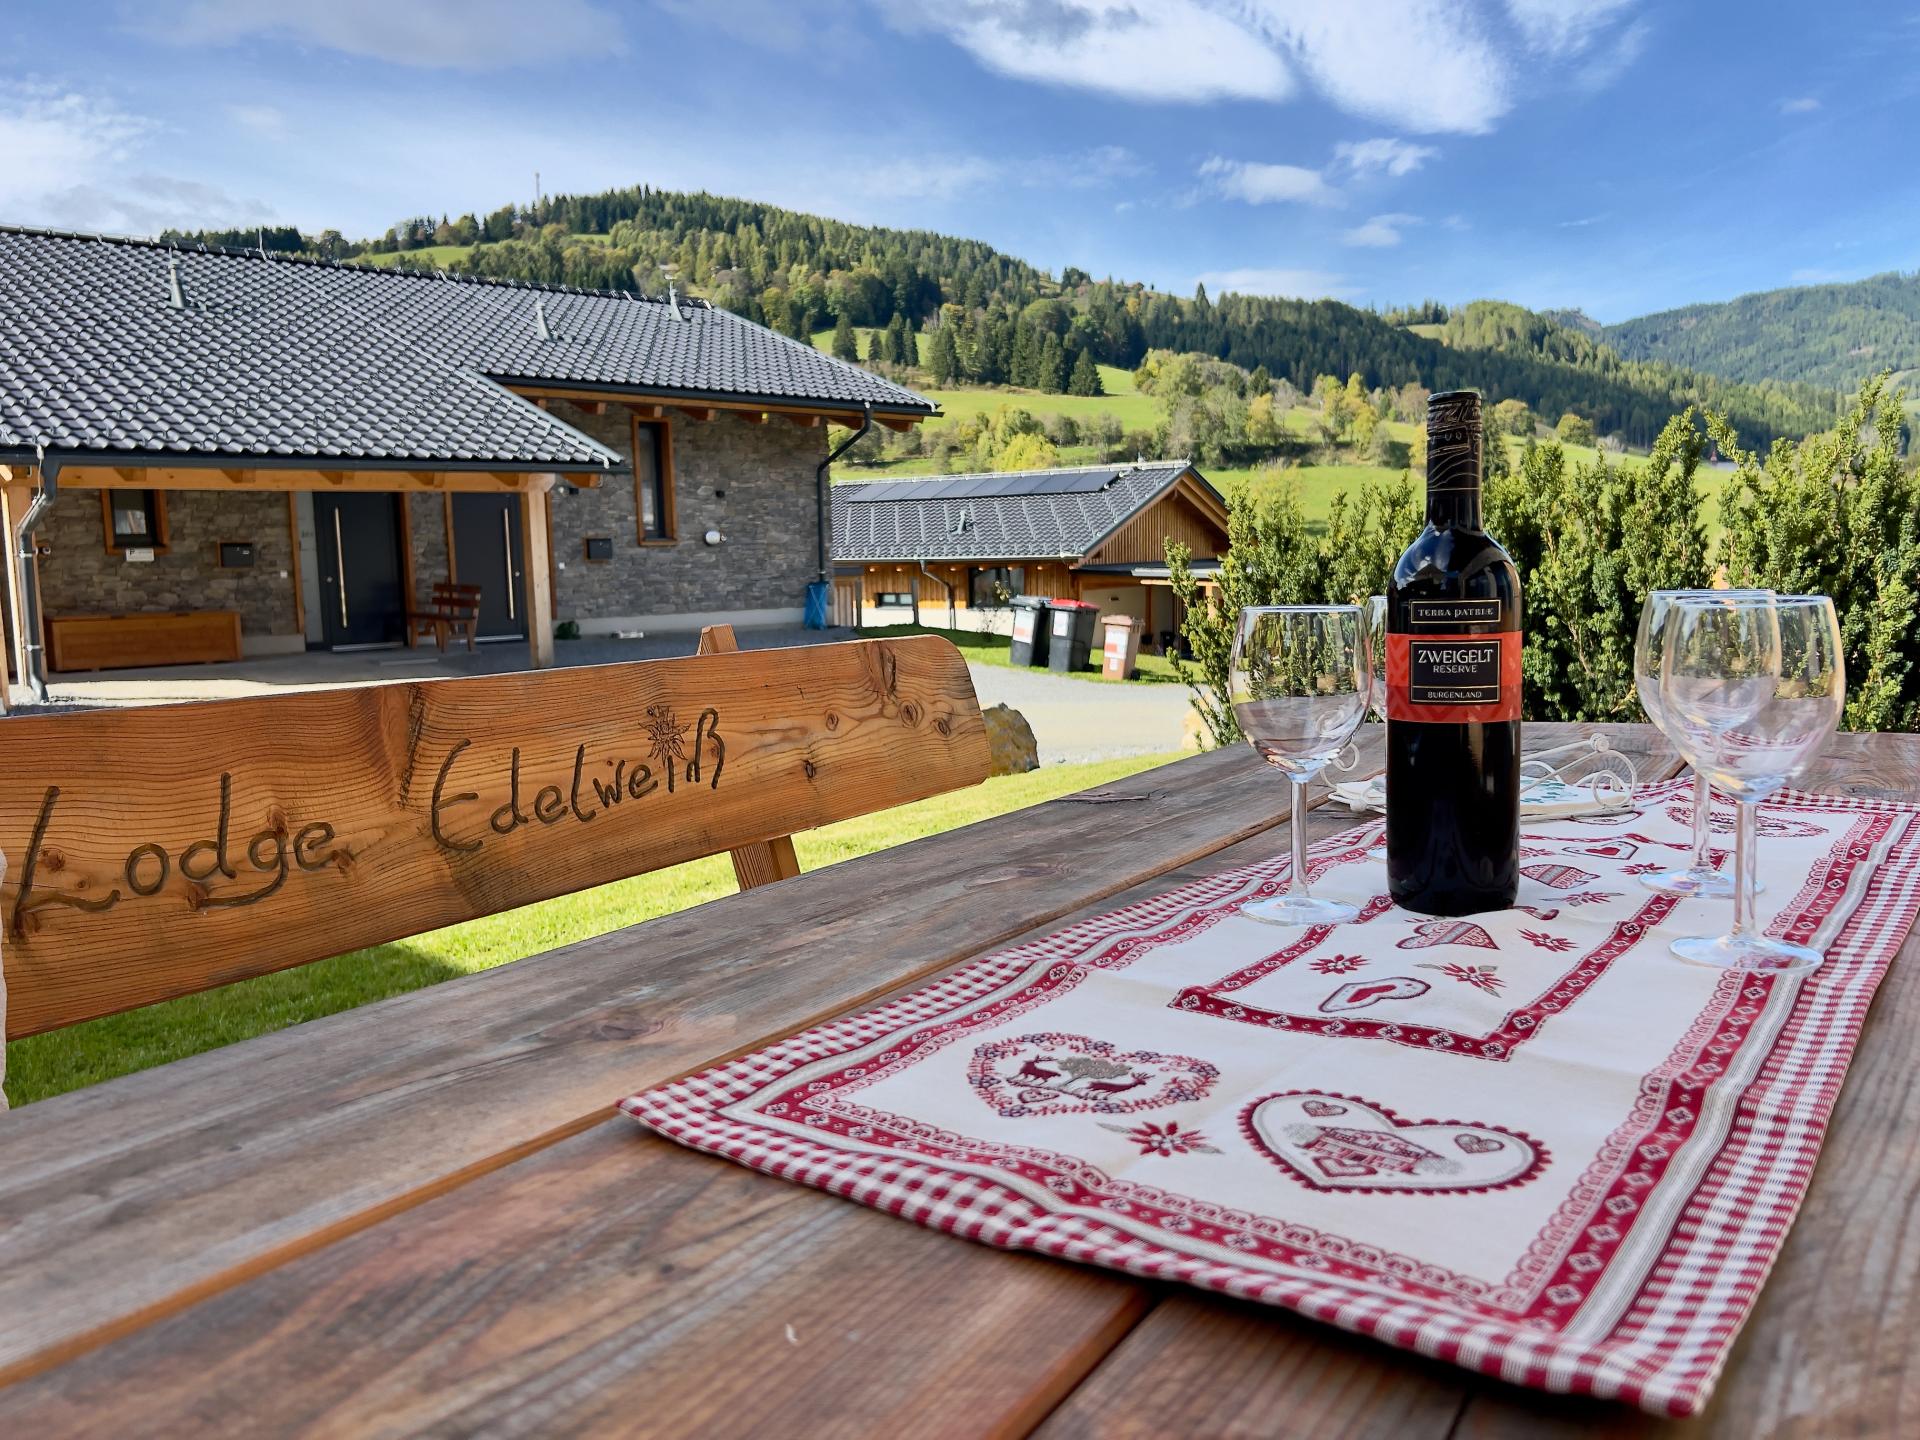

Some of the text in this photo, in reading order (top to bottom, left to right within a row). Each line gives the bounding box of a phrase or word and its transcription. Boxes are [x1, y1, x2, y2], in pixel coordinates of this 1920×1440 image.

[1418, 649, 1494, 664] ZWEIGELT
[1433, 664, 1478, 674] RESERVE
[1427, 691, 1482, 699] BURGENLAND
[8, 706, 726, 944] Lodge Edelweiß
